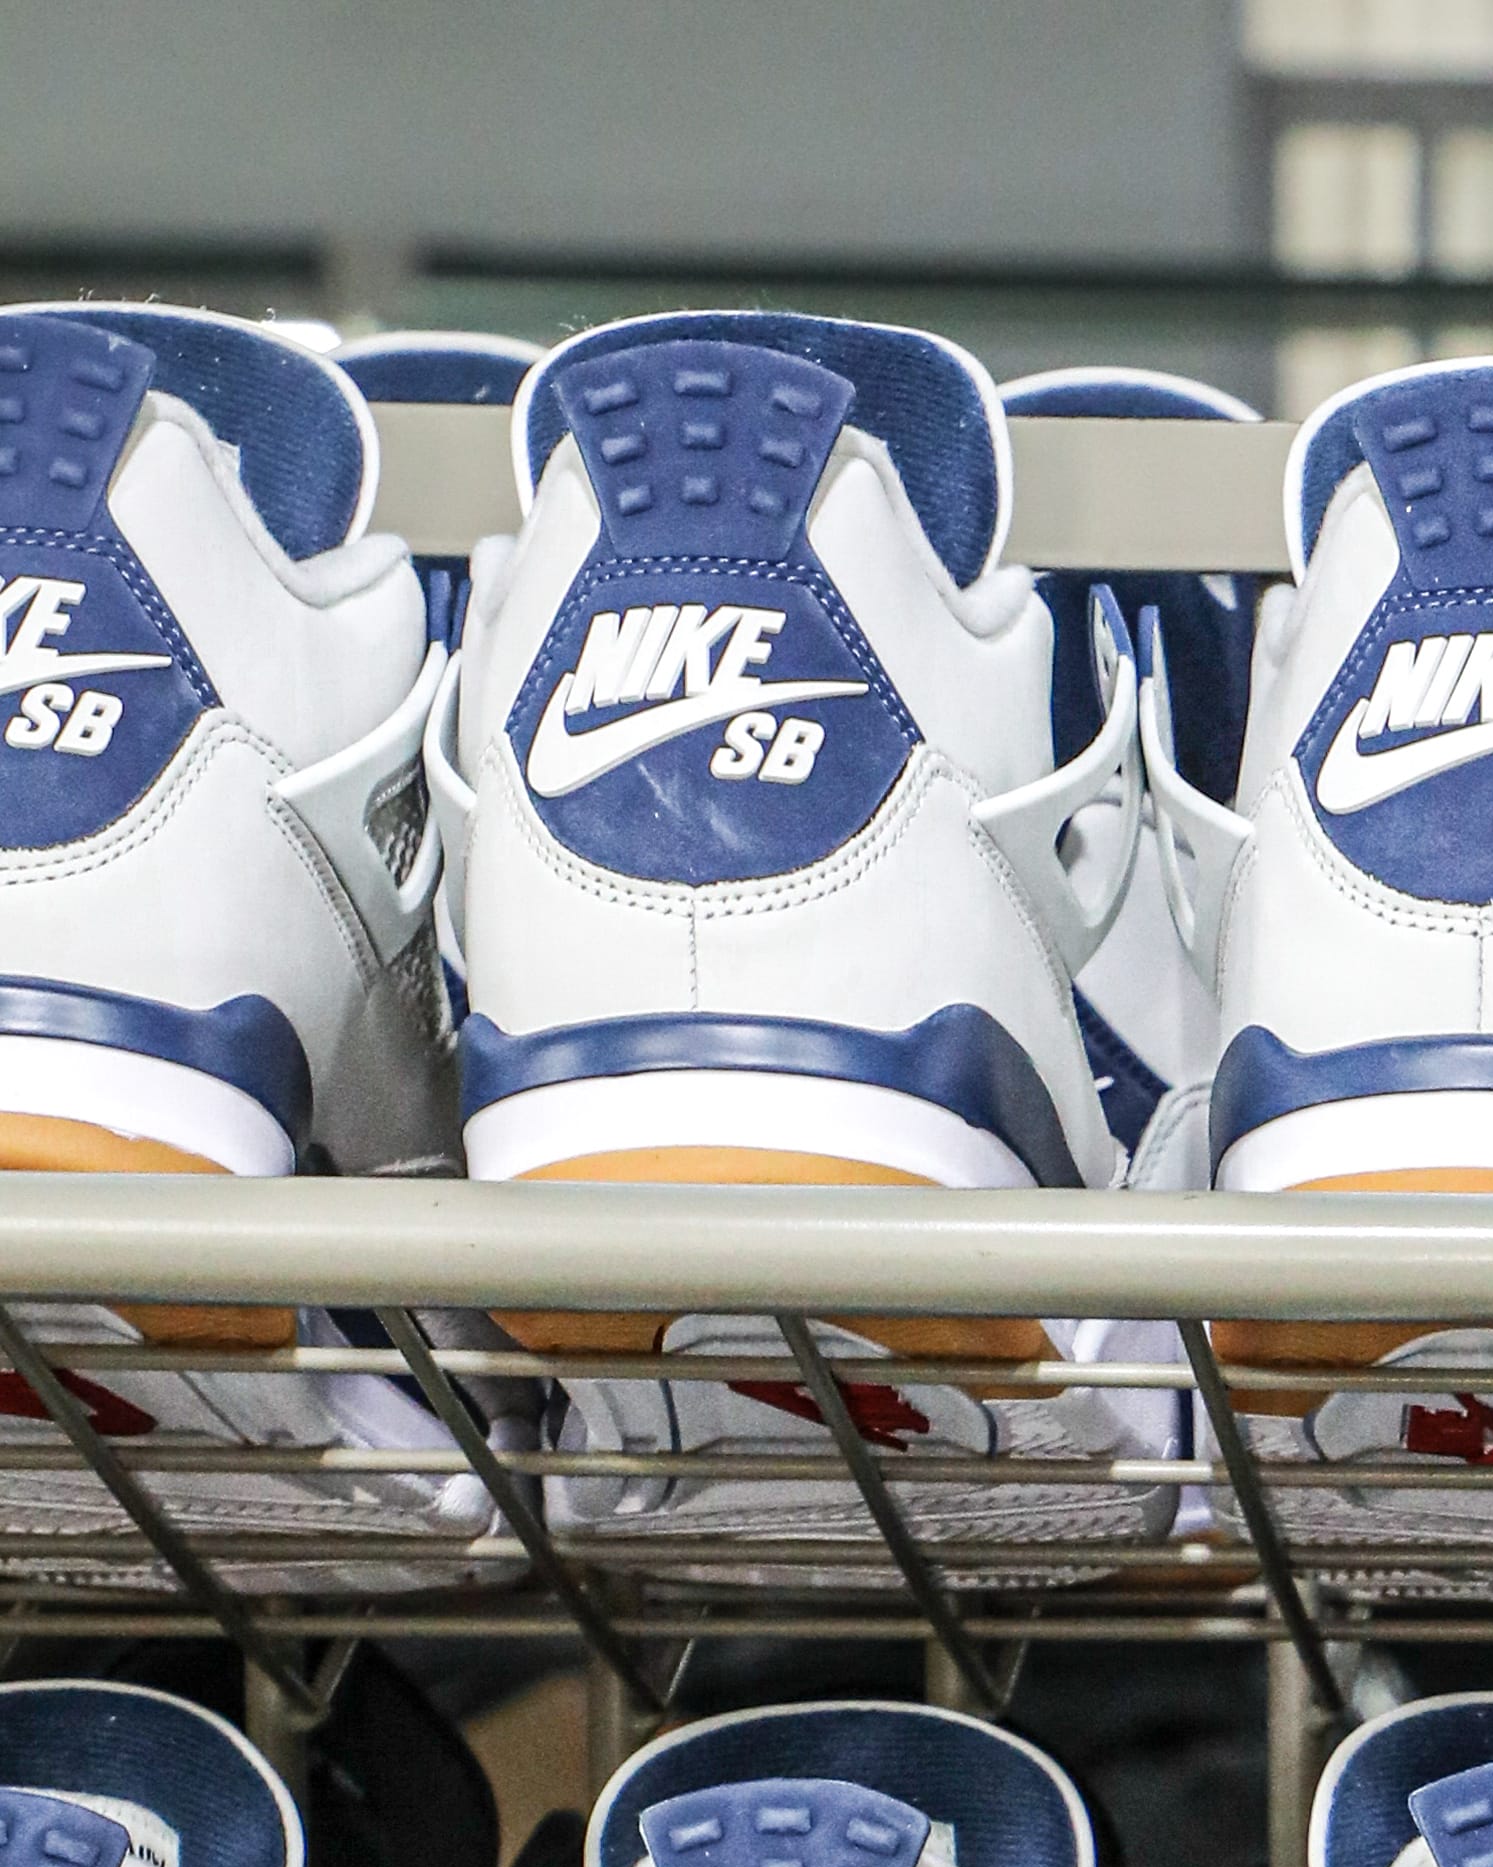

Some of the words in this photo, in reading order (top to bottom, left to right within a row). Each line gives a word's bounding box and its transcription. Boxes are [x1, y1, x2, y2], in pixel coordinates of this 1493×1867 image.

[566, 603, 788, 712] NIKE
[4, 683, 123, 757] SB
[708, 709, 827, 787] SB
